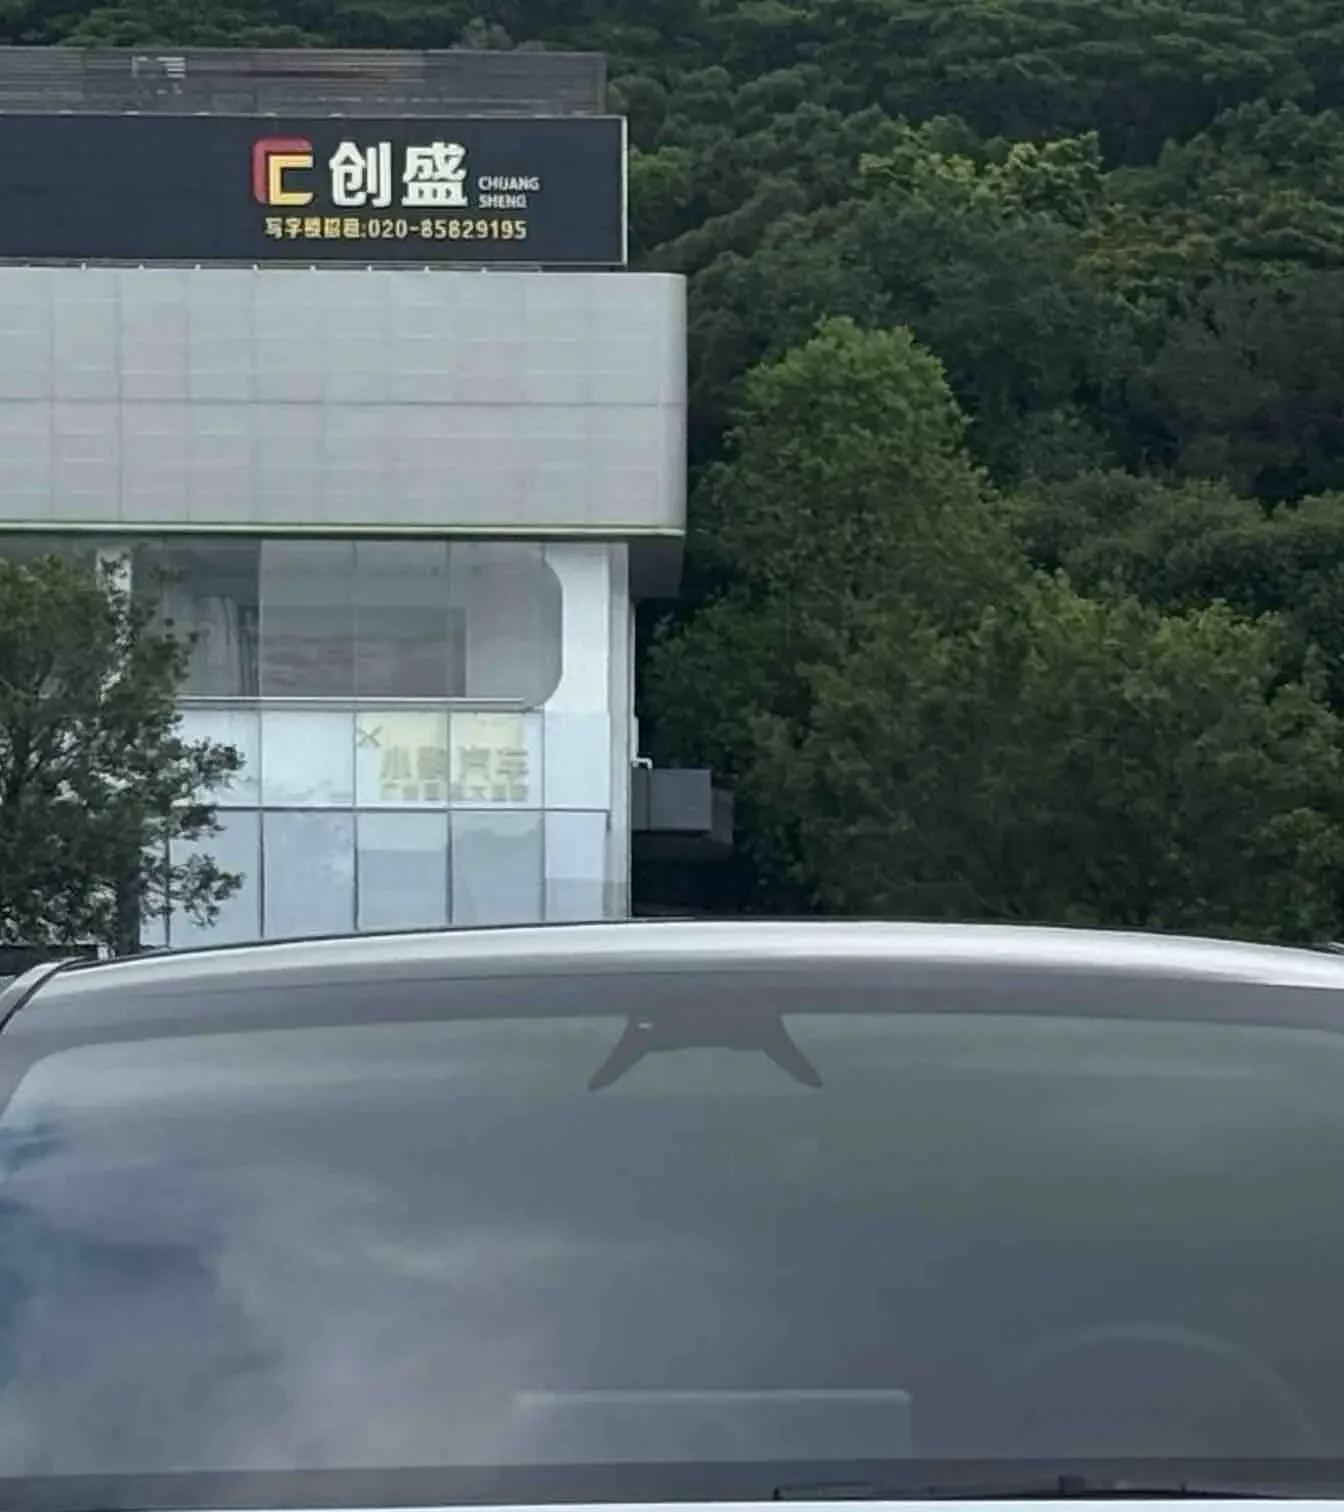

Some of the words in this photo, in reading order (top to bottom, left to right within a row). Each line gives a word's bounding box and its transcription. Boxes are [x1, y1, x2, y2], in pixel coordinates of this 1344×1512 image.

[328, 141, 469, 208] 创盛
[477, 175, 541, 191] CHUANG
[478, 193, 528, 209] SHENG
